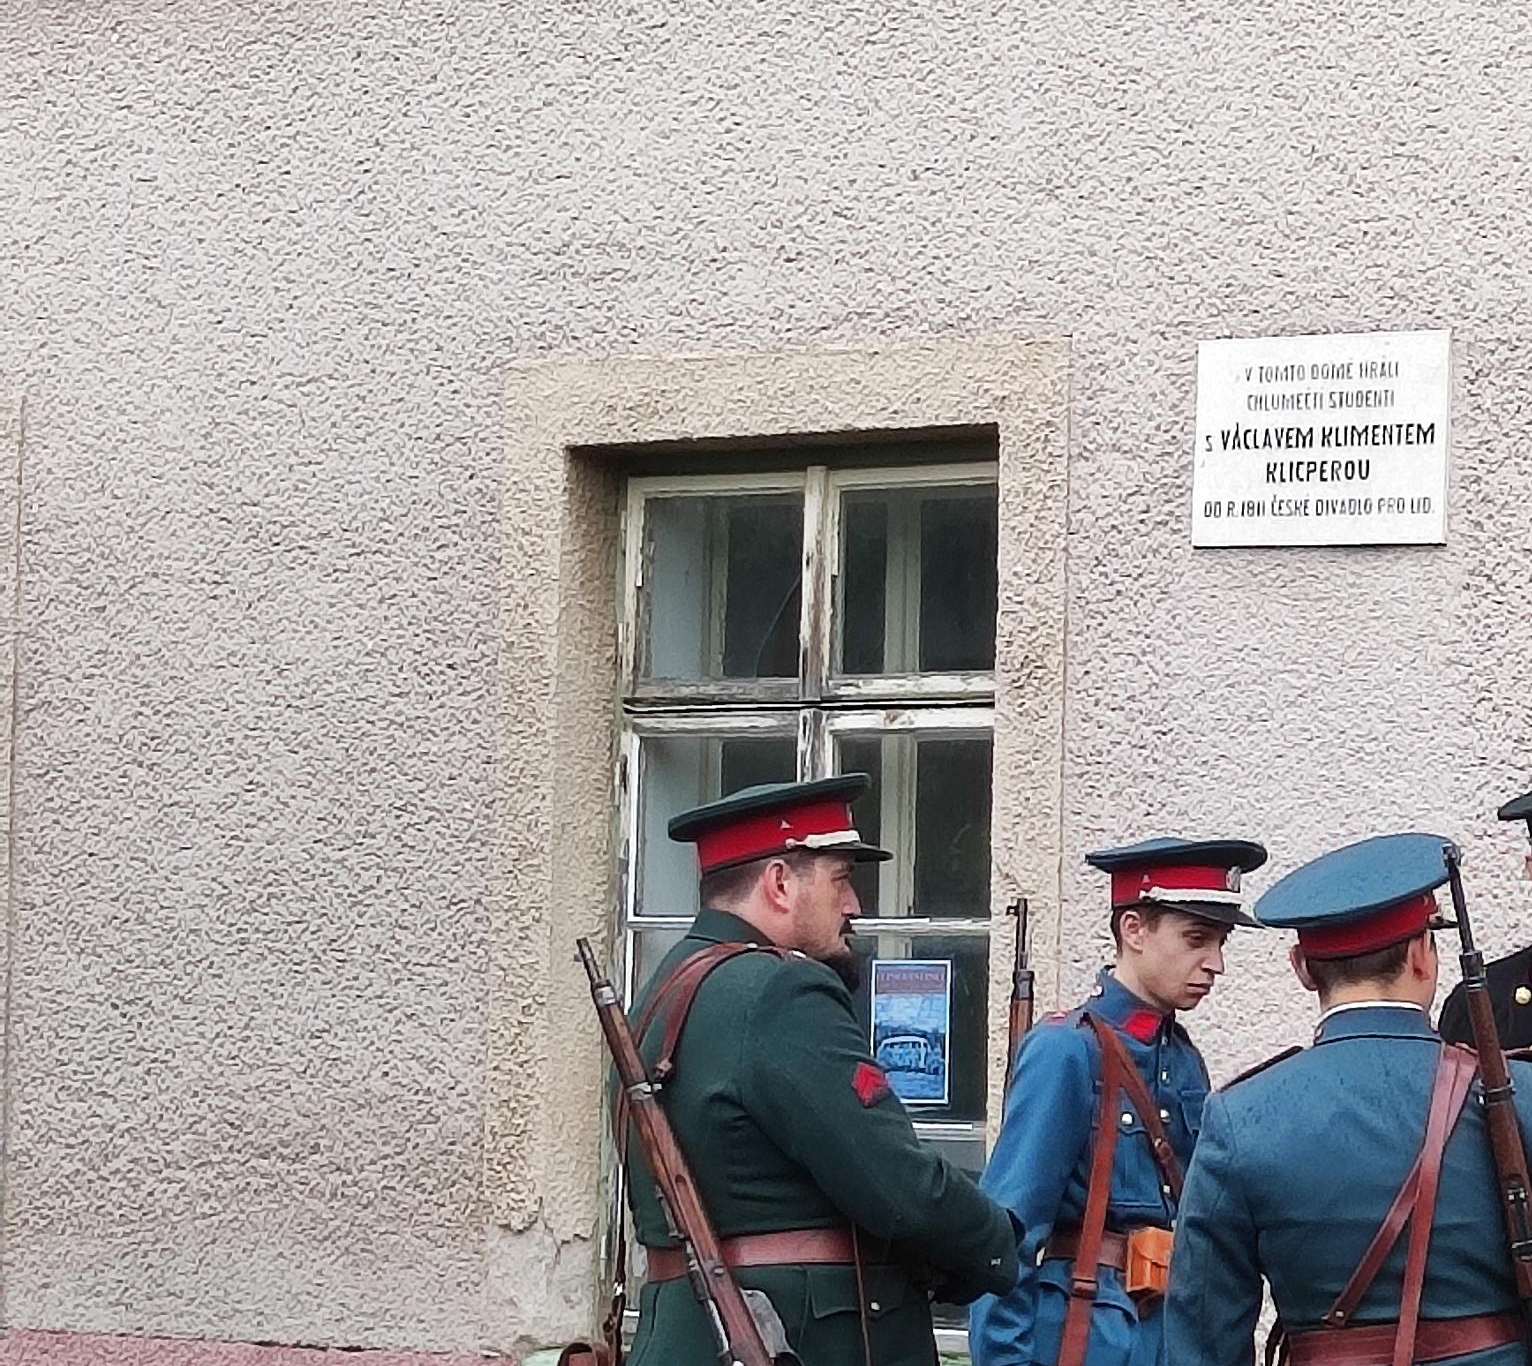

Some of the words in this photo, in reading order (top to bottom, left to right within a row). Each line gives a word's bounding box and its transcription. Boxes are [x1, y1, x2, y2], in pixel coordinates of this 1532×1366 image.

[1244, 366, 1254, 383] V
[1258, 363, 1306, 384] TOMTO
[1328, 389, 1395, 409] STUDENTI
[1220, 422, 1314, 451] VÁCLAVEM
[1321, 422, 1436, 448] KLIMENTEM
[1266, 458, 1371, 484] KLICPEROU
[1203, 500, 1222, 518] OD
[1270, 494, 1310, 517] ČESKÉ
[1315, 497, 1373, 517] DIVADLO
[1377, 496, 1405, 515] PRO
